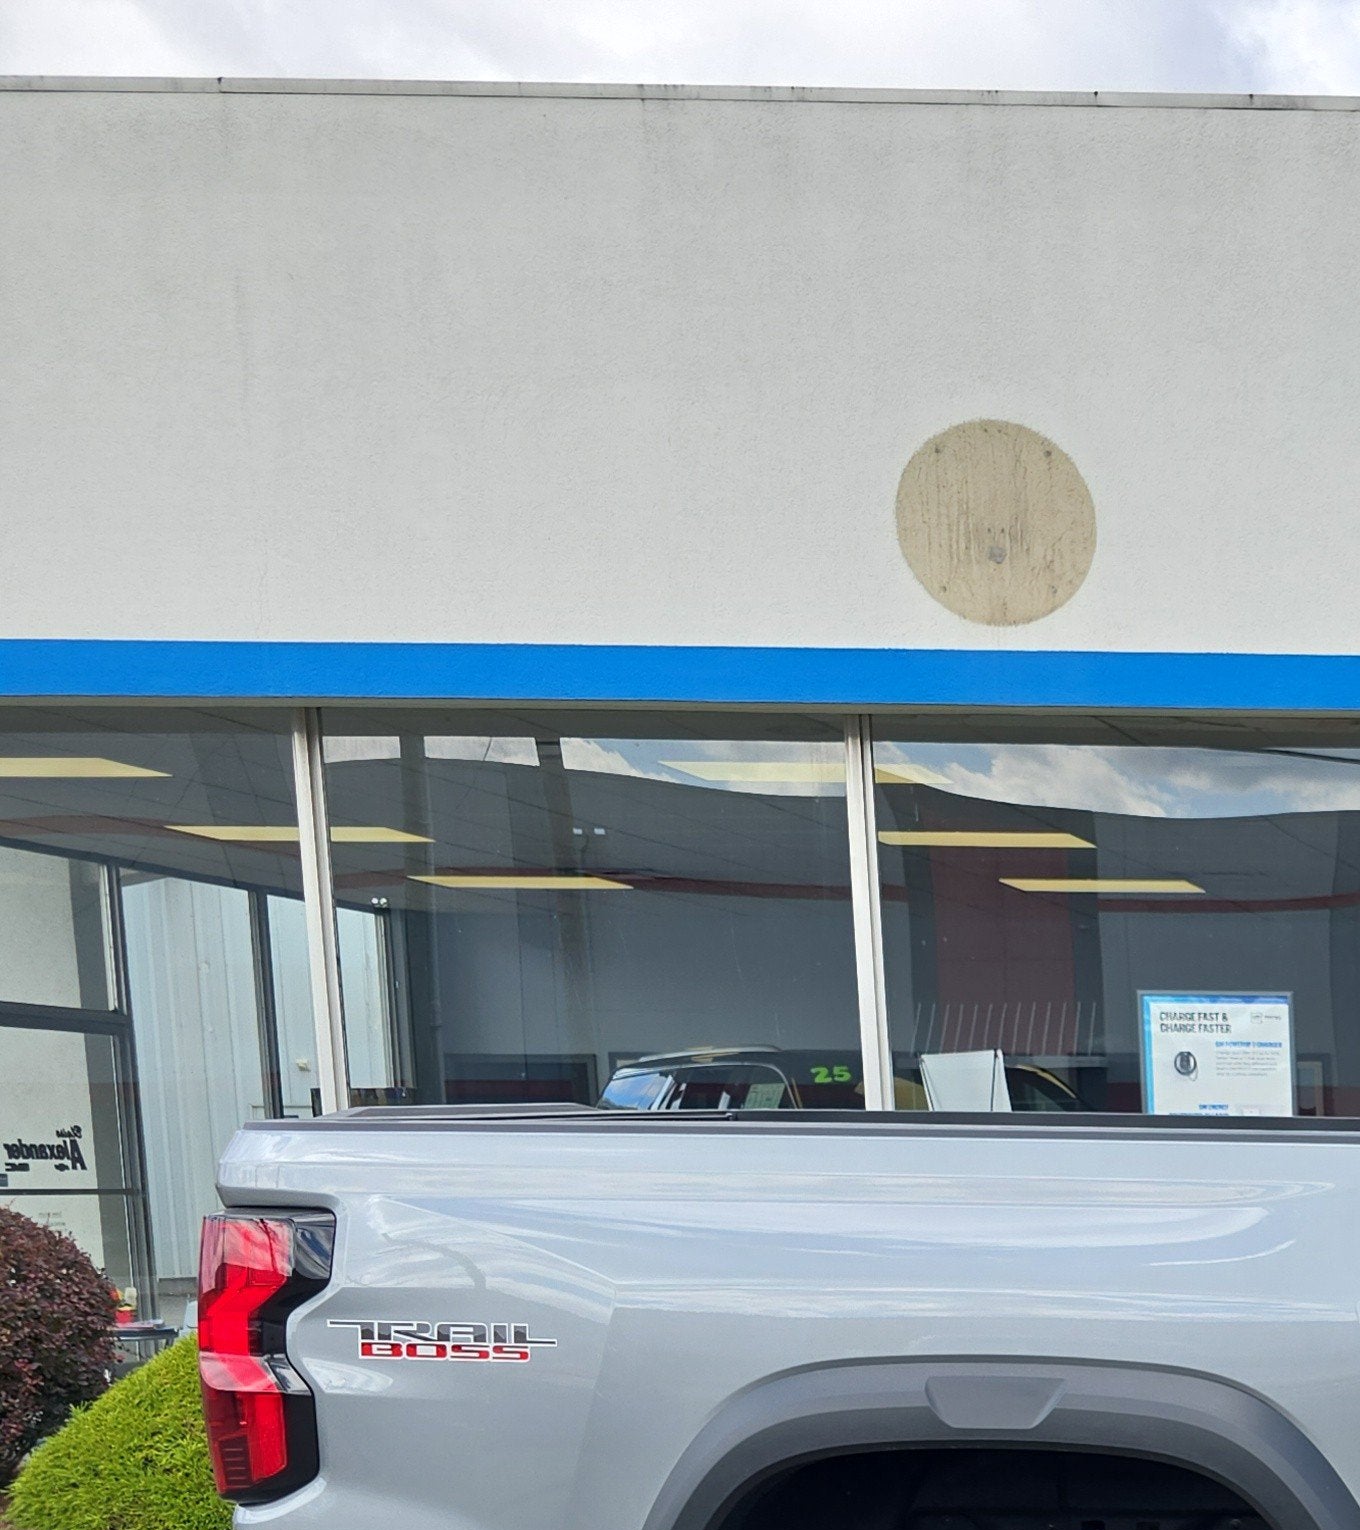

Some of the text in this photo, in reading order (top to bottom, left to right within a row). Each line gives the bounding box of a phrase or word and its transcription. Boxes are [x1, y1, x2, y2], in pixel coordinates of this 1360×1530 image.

[1160, 1012, 1195, 1021] CHARGE
[1198, 1012, 1219, 1021] FAST
[1160, 1024, 1231, 1033] CHARGE FASTER
[811, 1066, 851, 1083] 25
[327, 1319, 557, 1347] TRAIL
[360, 1342, 530, 1362] BOSS
